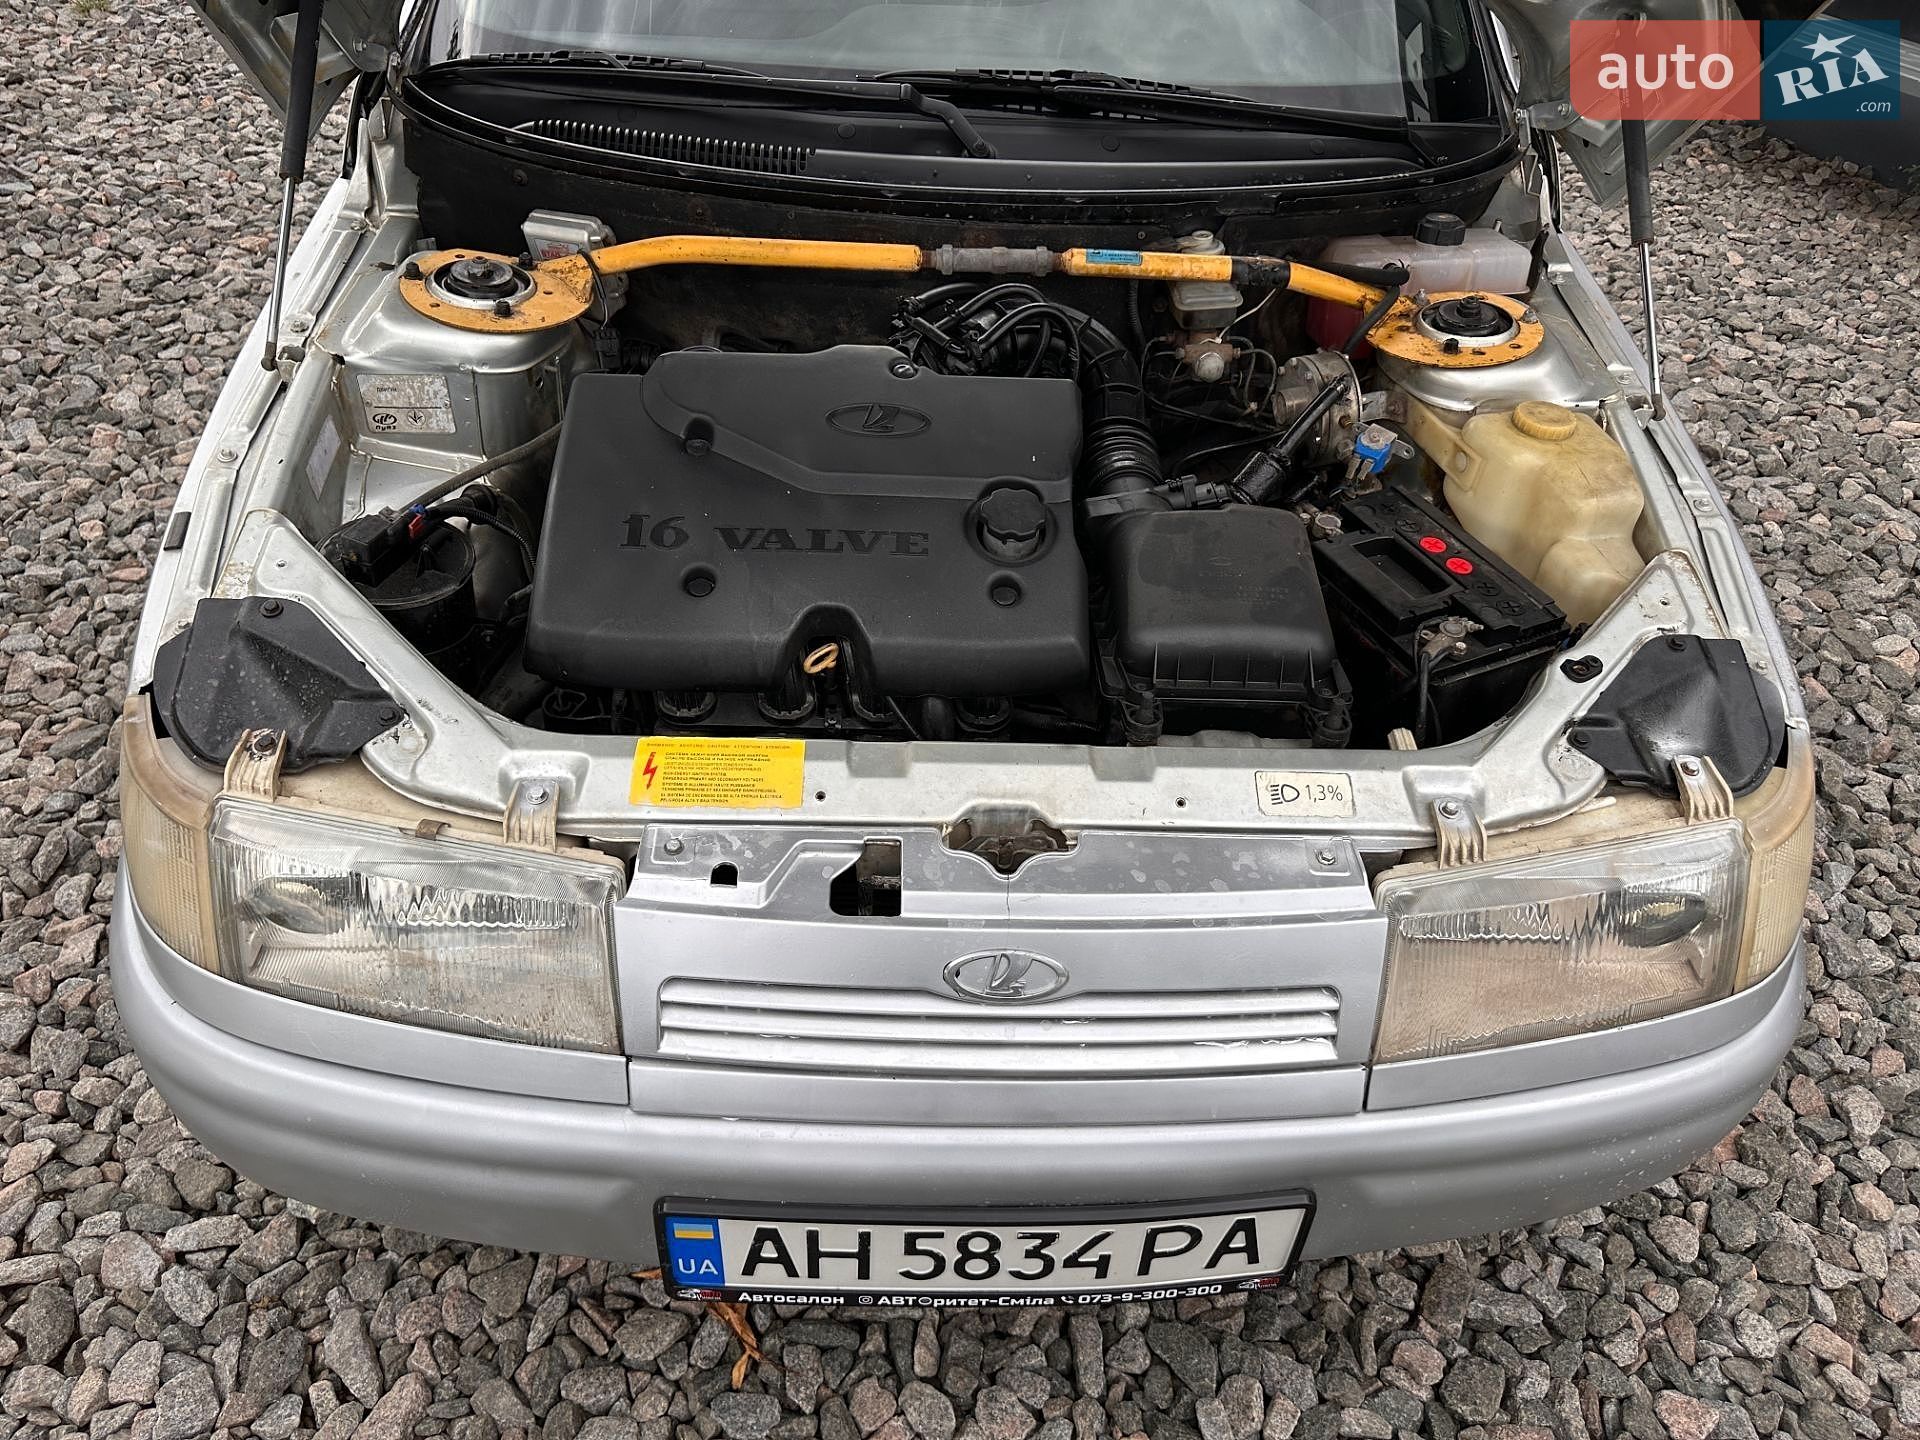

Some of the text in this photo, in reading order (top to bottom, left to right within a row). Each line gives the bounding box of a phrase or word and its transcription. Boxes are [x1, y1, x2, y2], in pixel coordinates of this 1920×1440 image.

[617, 513, 930, 557] 16 VALVE
[1305, 784, 1343, 803] 1,3%
[741, 1216, 1260, 1281] AH 5834 PA
[678, 1258, 719, 1275] UA
[738, 1292, 845, 1304] Автосалон
[1078, 1284, 1223, 1304] 073-9-300-300
